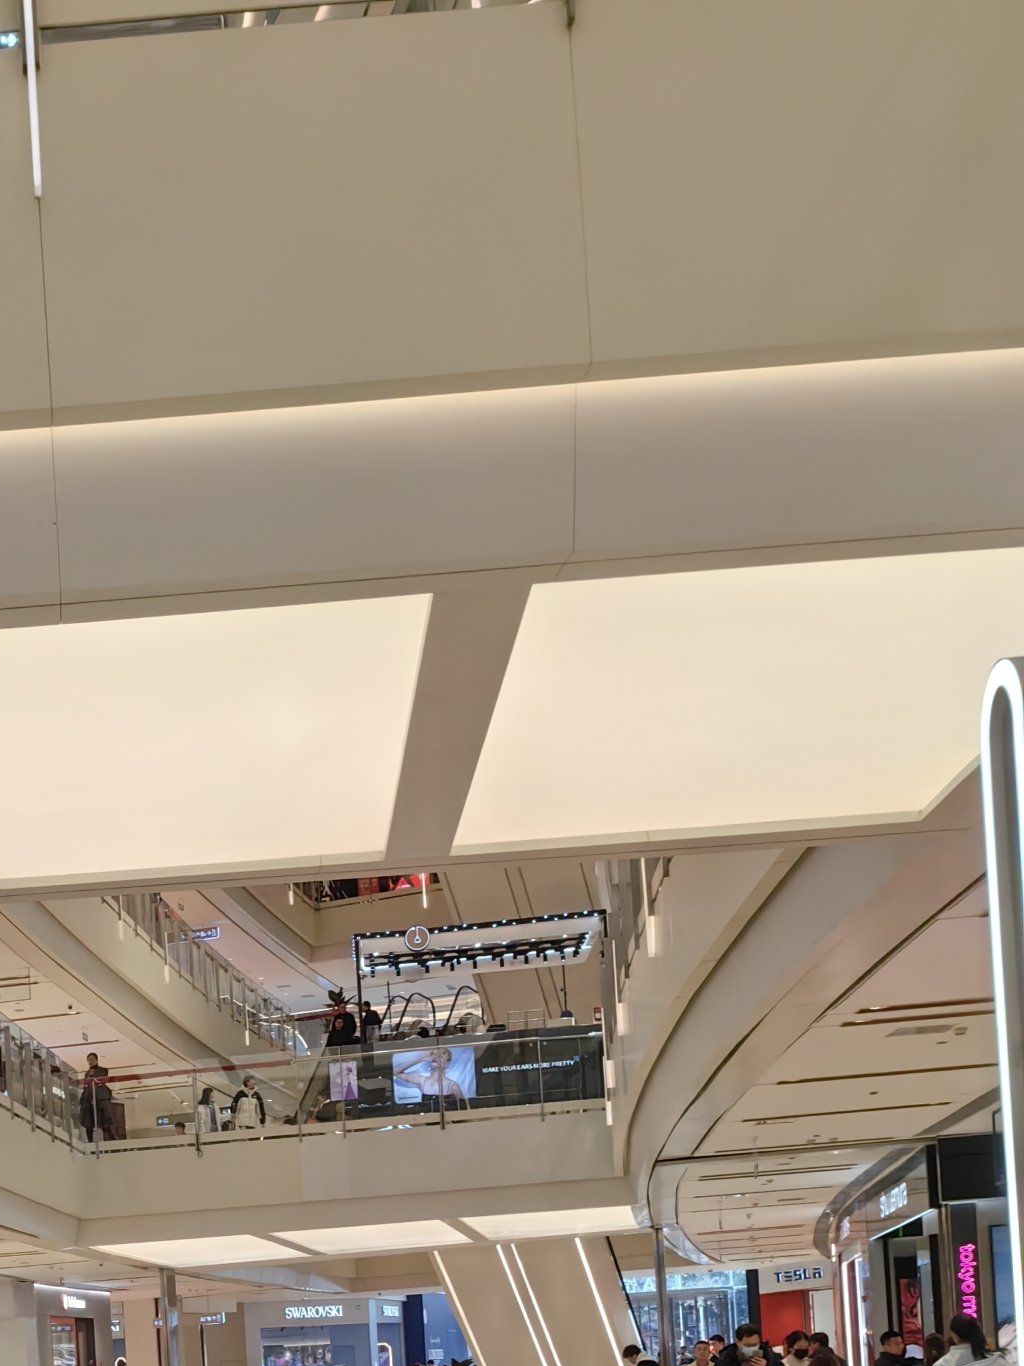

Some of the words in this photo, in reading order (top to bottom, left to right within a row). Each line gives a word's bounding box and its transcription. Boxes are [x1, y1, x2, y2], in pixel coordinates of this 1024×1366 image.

[482, 1066, 499, 1074] MAKE
[774, 1267, 824, 1283] TESLA
[958, 1244, 977, 1294] tokyo
[285, 1305, 343, 1319] SWAROVSKI
